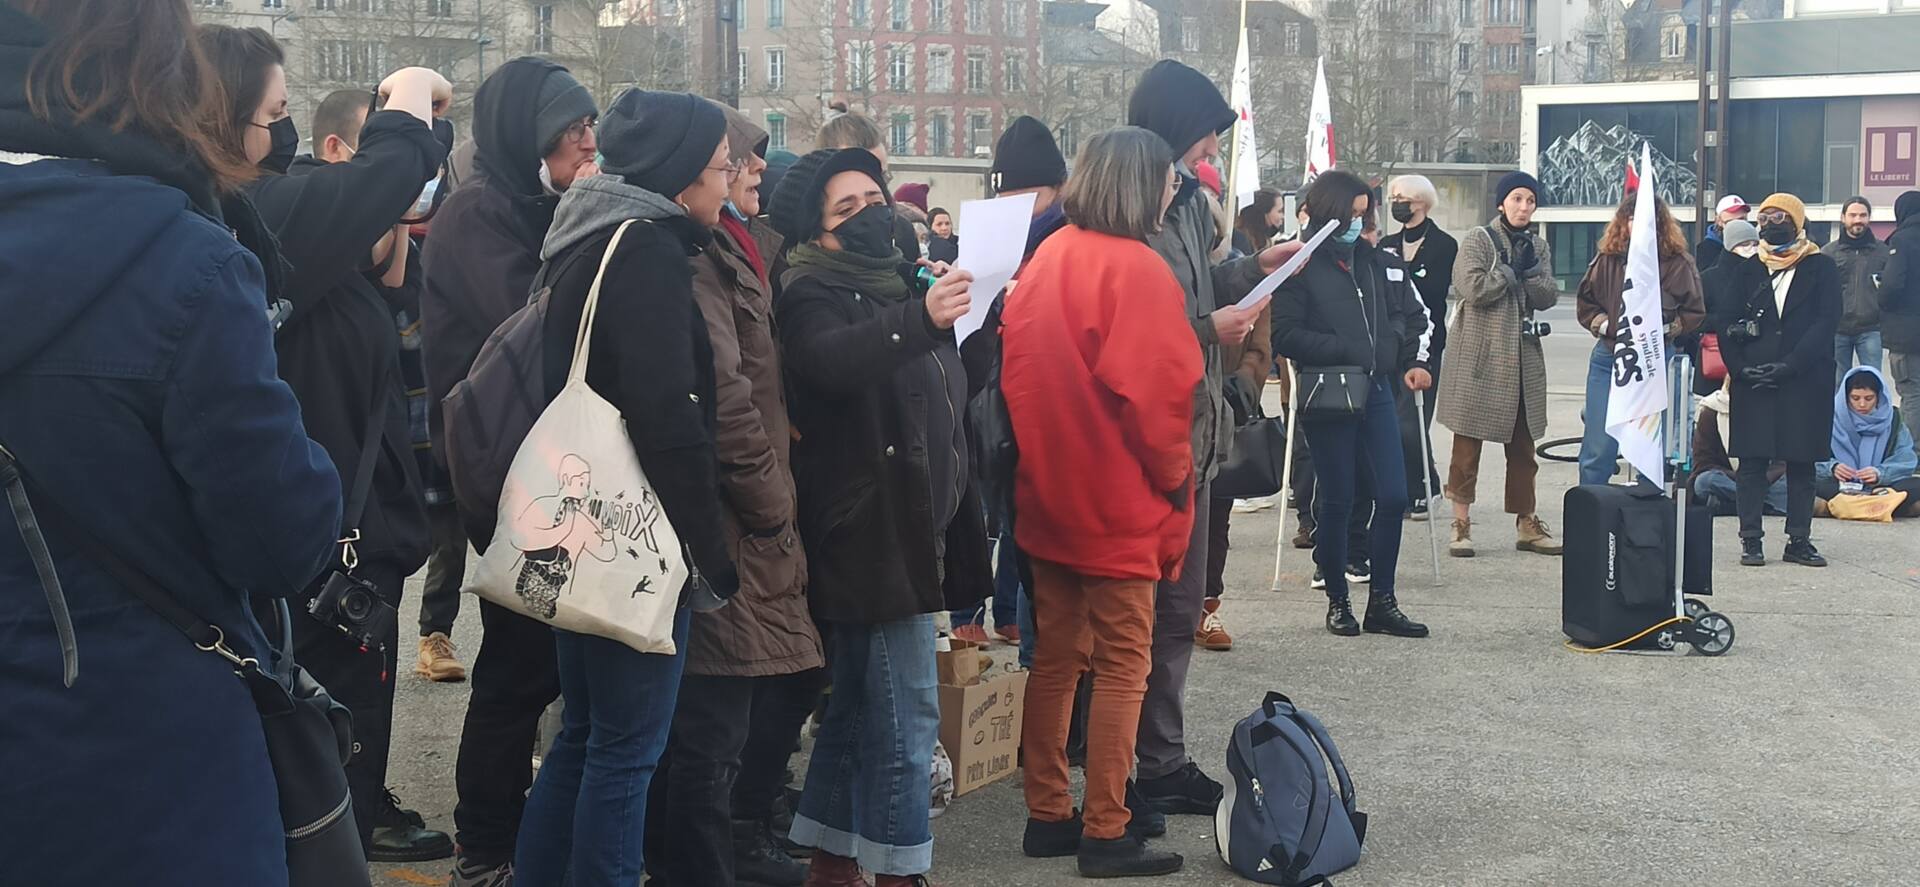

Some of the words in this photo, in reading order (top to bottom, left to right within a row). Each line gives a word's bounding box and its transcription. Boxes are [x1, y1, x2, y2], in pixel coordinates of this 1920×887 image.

[1880, 173, 1910, 181] LIBERTÉ
[1638, 332, 1657, 379] syndicale
[1650, 329, 1661, 360] Union
[990, 710, 1014, 743] THÉ
